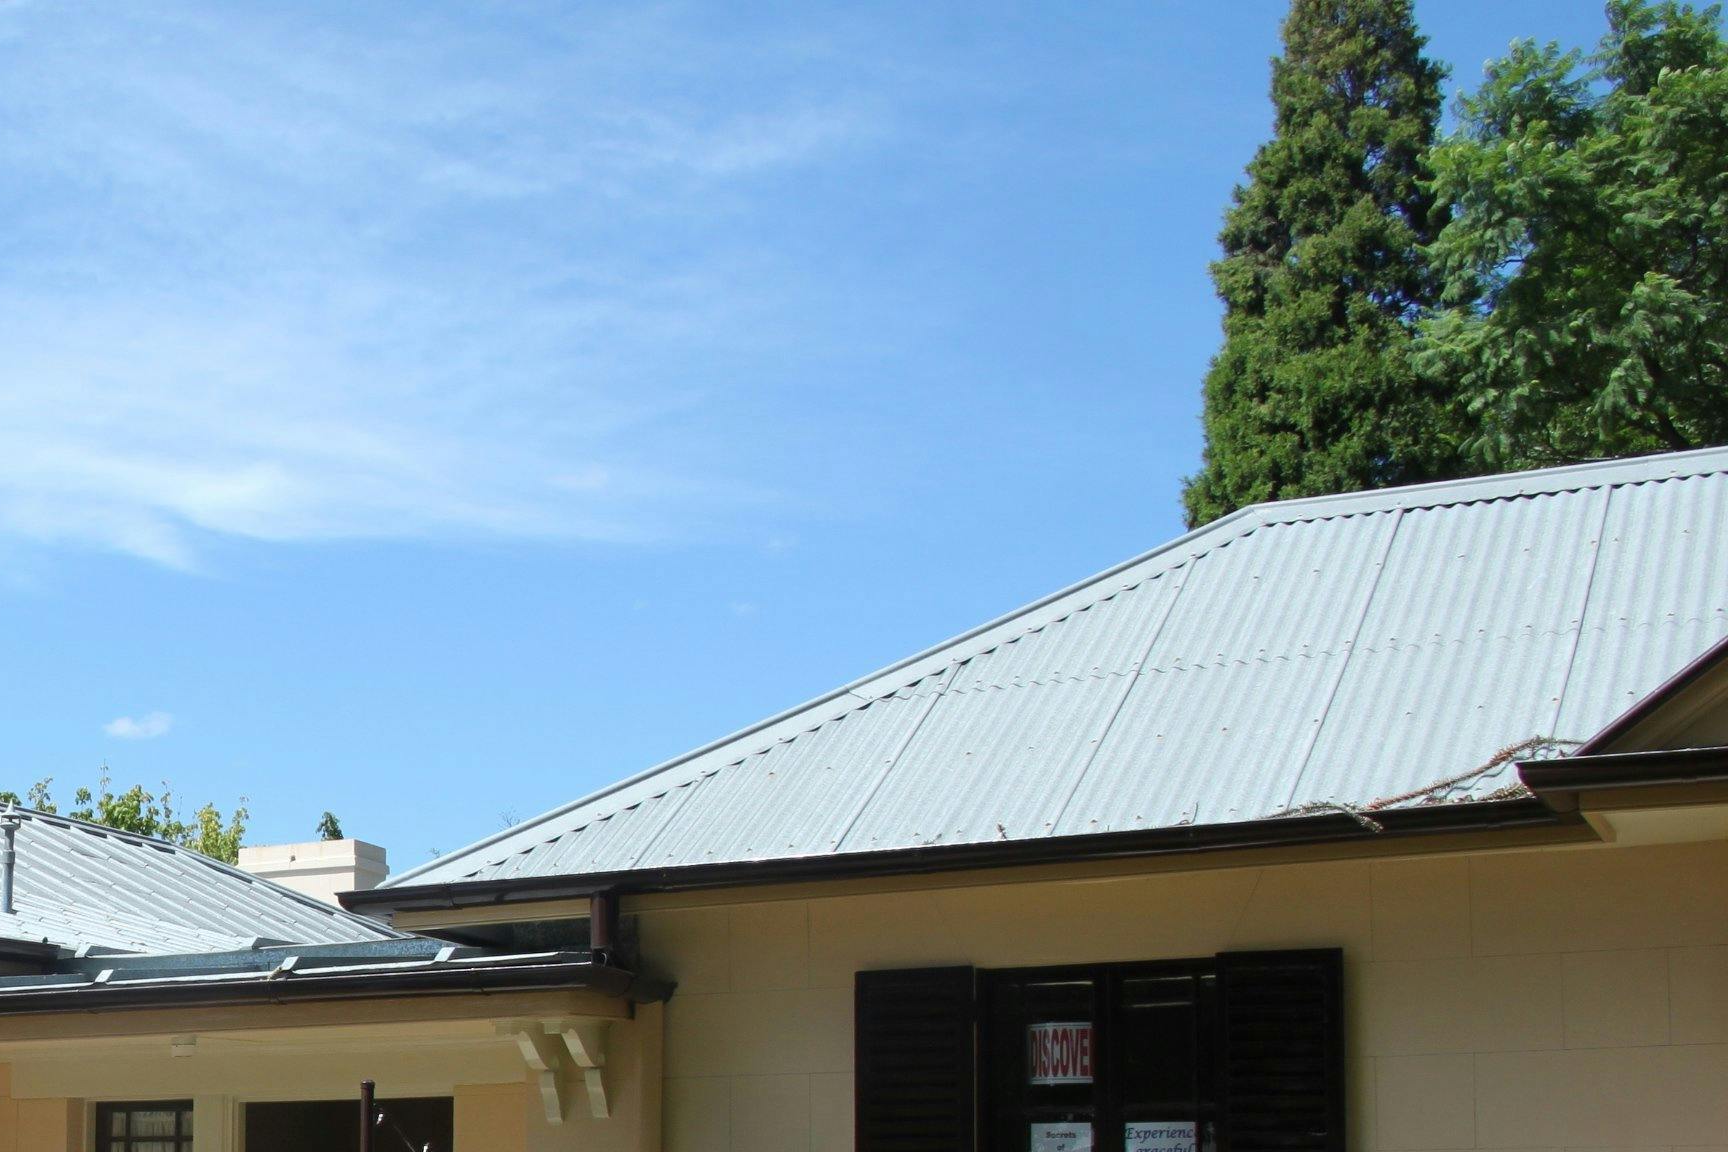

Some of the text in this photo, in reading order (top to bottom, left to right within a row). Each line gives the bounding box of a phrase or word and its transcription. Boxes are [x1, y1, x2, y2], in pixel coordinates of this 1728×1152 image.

[1030, 1028, 1094, 1077] DISCOVE
[1045, 1131, 1077, 1139] Secrets
[1125, 1127, 1198, 1144] Experienc
[1056, 1143, 1065, 1152] of
